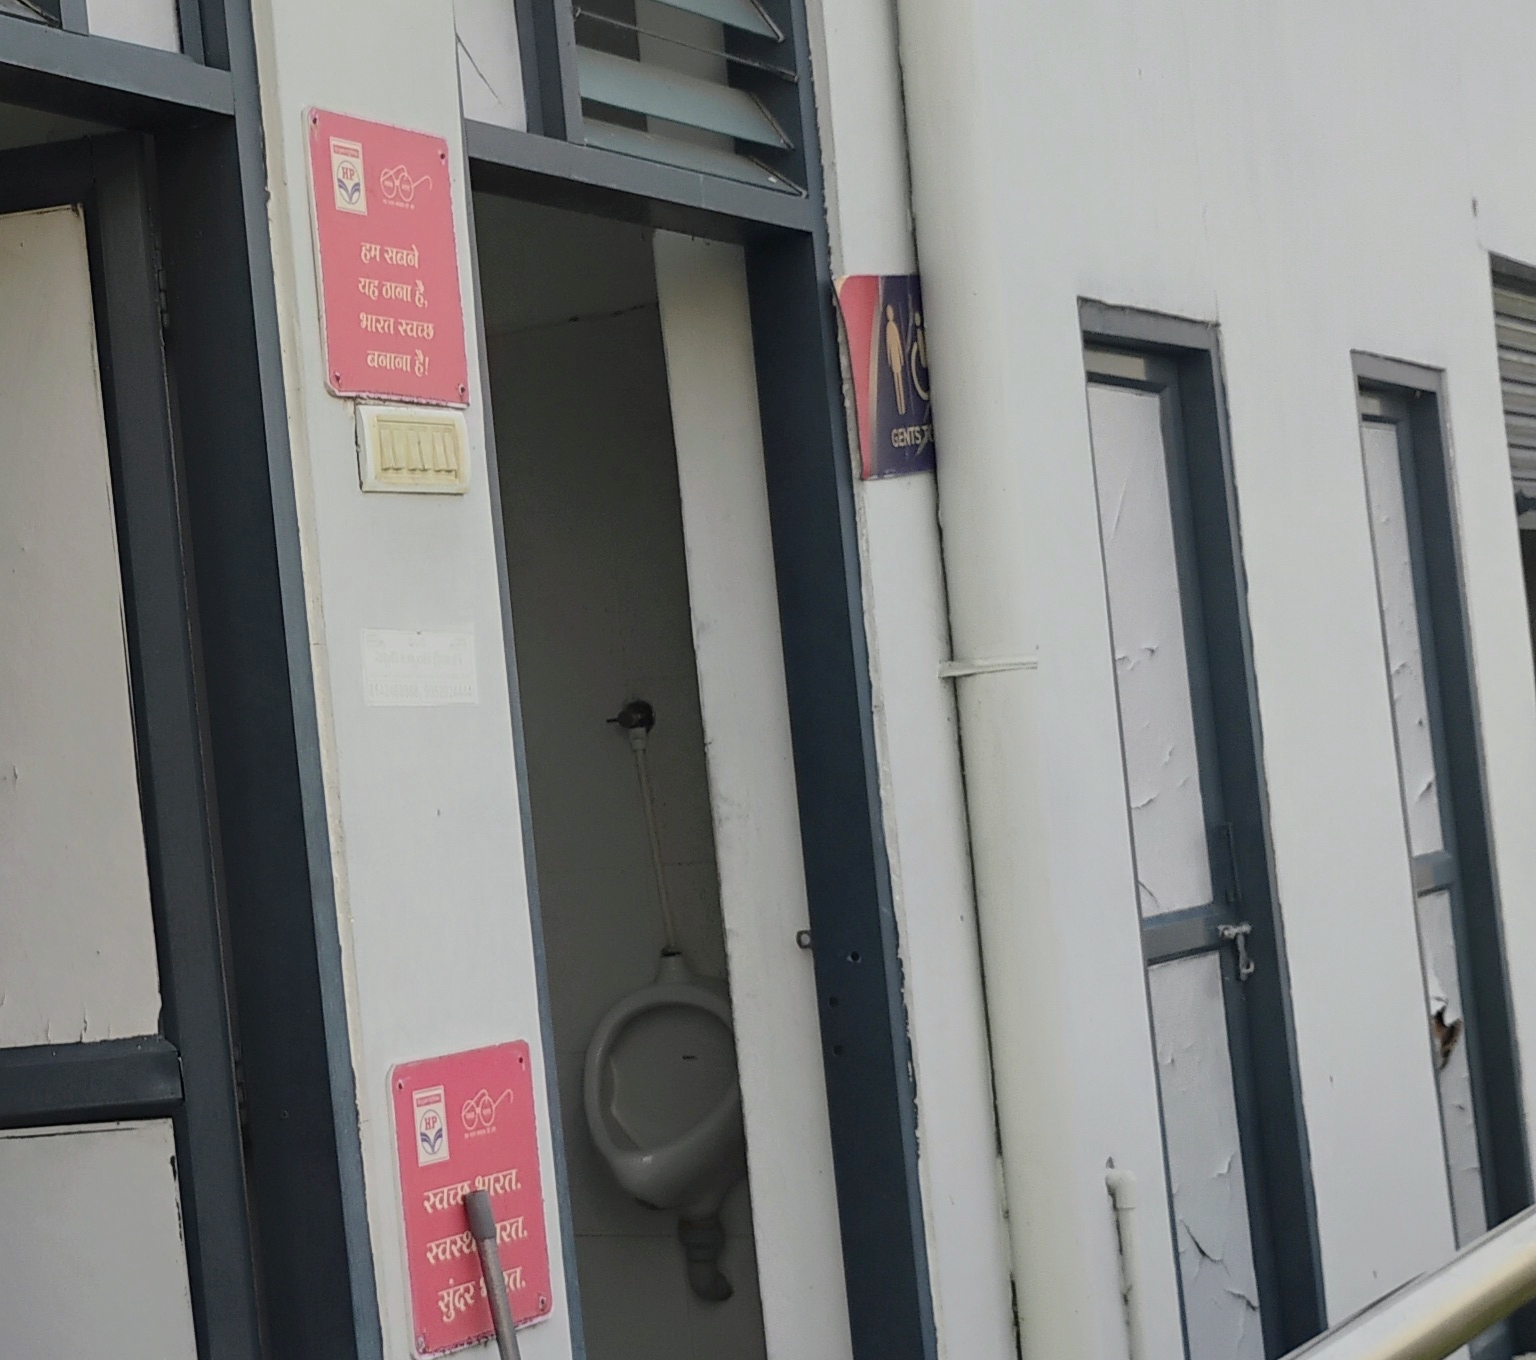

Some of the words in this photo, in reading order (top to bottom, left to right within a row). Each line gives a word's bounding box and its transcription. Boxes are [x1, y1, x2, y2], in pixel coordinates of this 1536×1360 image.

[360, 241, 380, 265] हम
[384, 243, 420, 270] सबने
[358, 277, 379, 301] यह
[382, 280, 411, 303] ठाना
[414, 279, 428, 309] है,
[359, 311, 394, 336] भारत
[397, 318, 434, 341] स्वच्छ
[367, 349, 410, 374] बनाना
[414, 349, 429, 378] है!
[892, 426, 922, 448] GENTS
[438, 1278, 475, 1323] सुंदर
